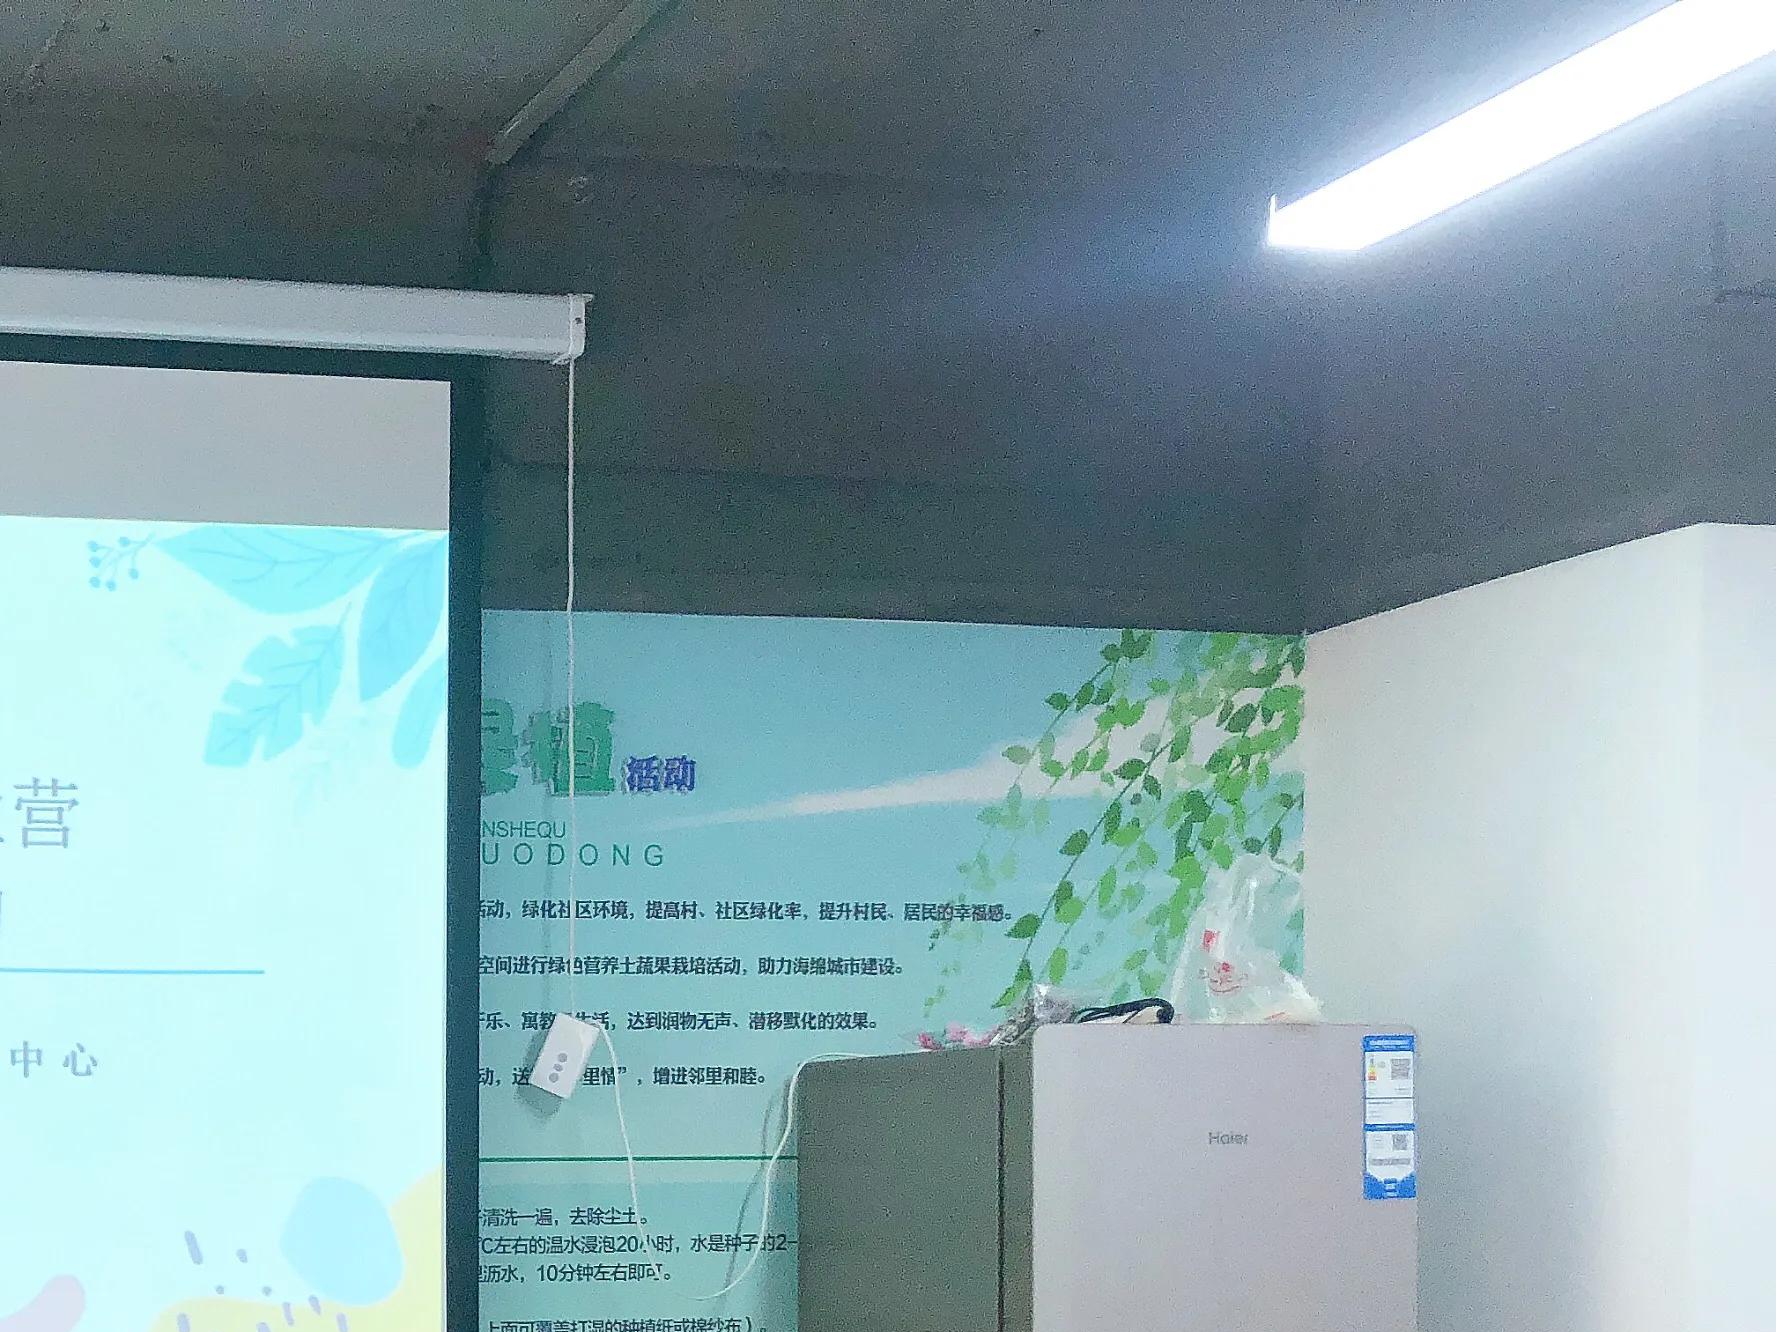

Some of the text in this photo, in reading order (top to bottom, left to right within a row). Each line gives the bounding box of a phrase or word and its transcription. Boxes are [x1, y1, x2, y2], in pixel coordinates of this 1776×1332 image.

[626, 754, 697, 793] 活动
[481, 820, 567, 839] NSHEQU
[1208, 1130, 1249, 1146] Haier
[478, 1206, 648, 1228] 清洗一遍，去除尘土。
